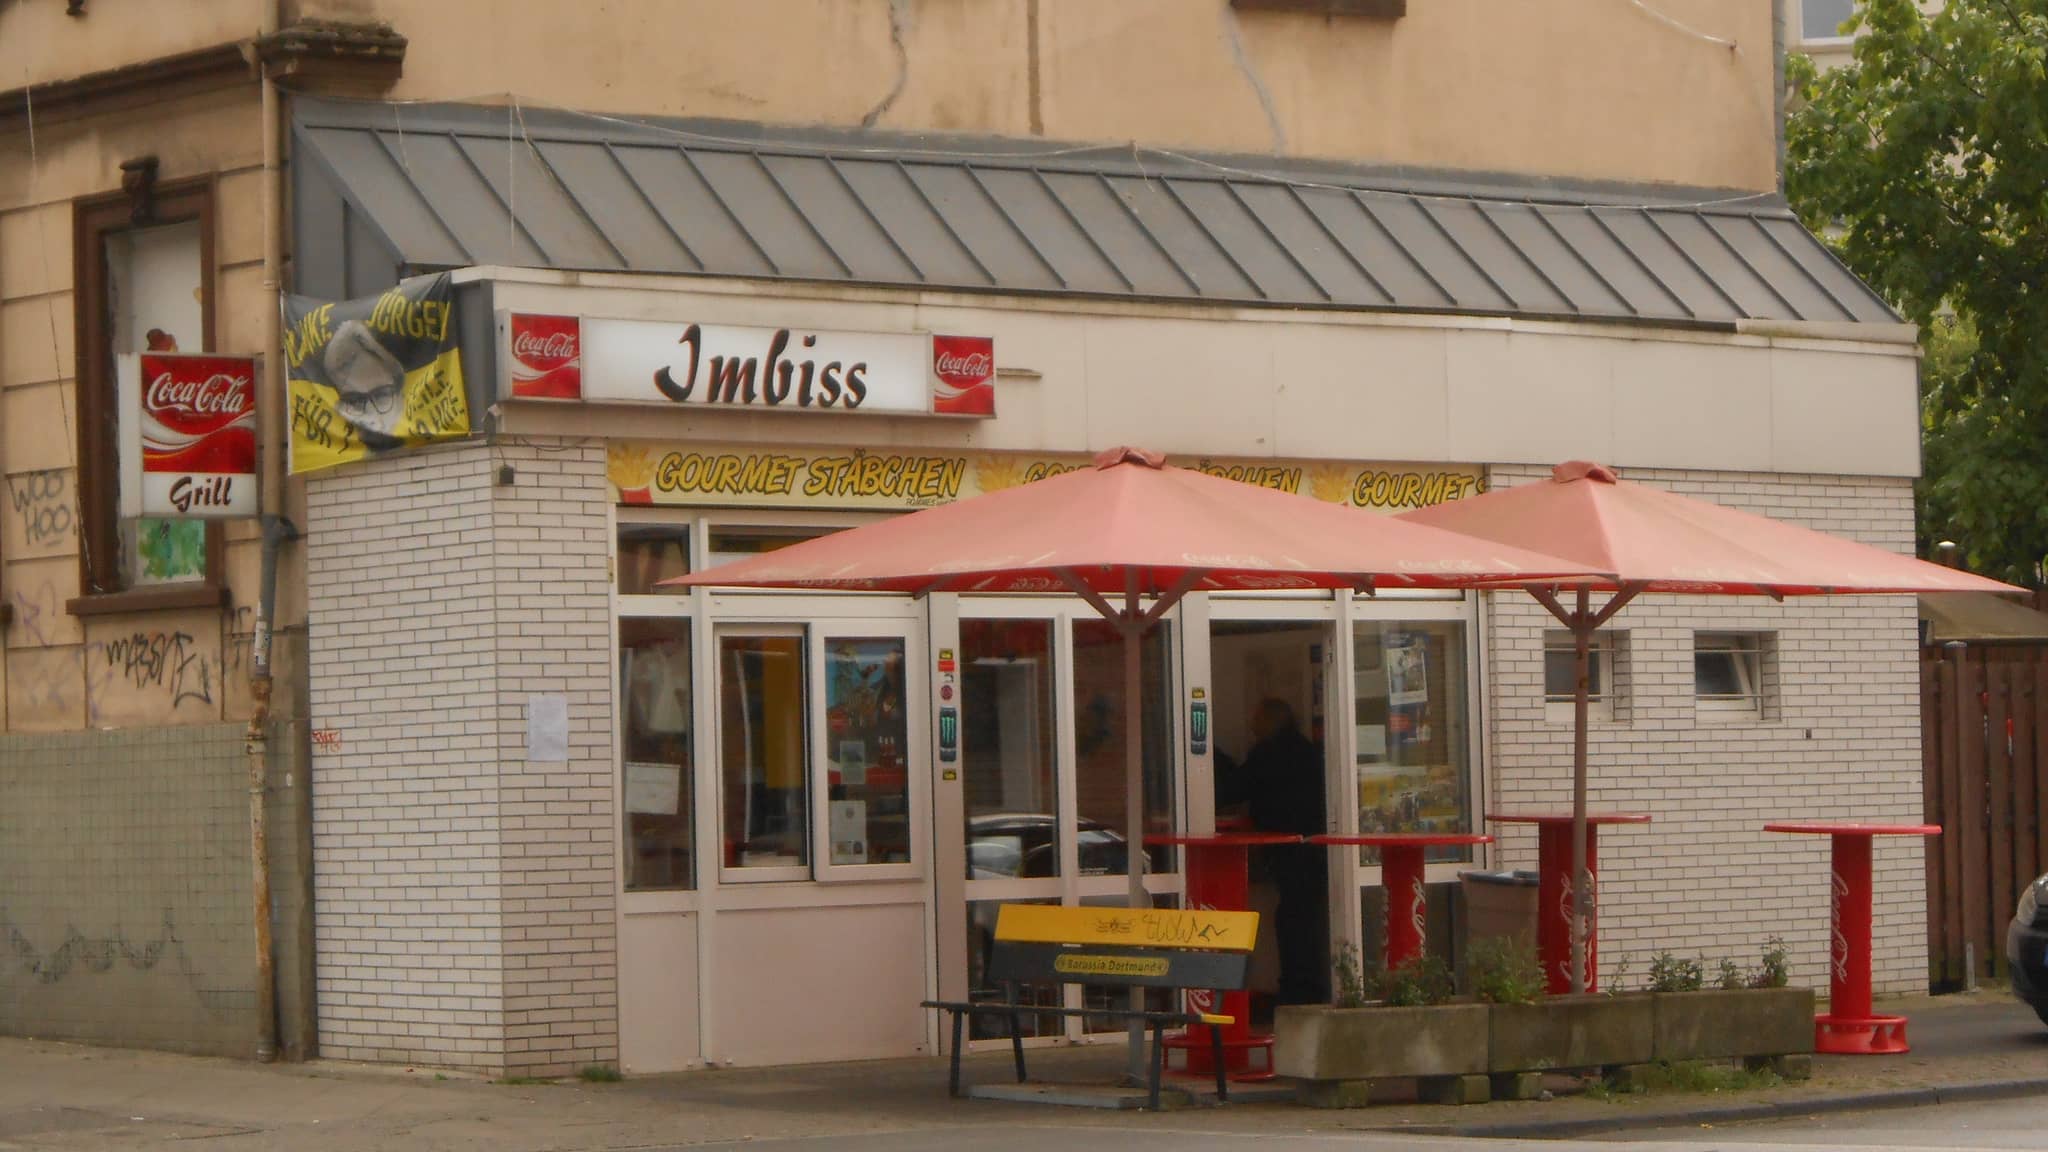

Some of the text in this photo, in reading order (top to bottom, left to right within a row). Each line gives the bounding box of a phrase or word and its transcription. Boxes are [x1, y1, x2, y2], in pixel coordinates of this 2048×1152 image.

[514, 330, 576, 358] Coca-Cola
[936, 351, 991, 377] Coca-Cola
[147, 371, 250, 413] Coca-Cola
[292, 393, 333, 449] FÜR
[656, 447, 967, 498] GOURMET STÄBCHEN
[1353, 470, 1474, 508] GOURMET
[169, 476, 232, 512] Grill
[24, 504, 71, 544] HOO
